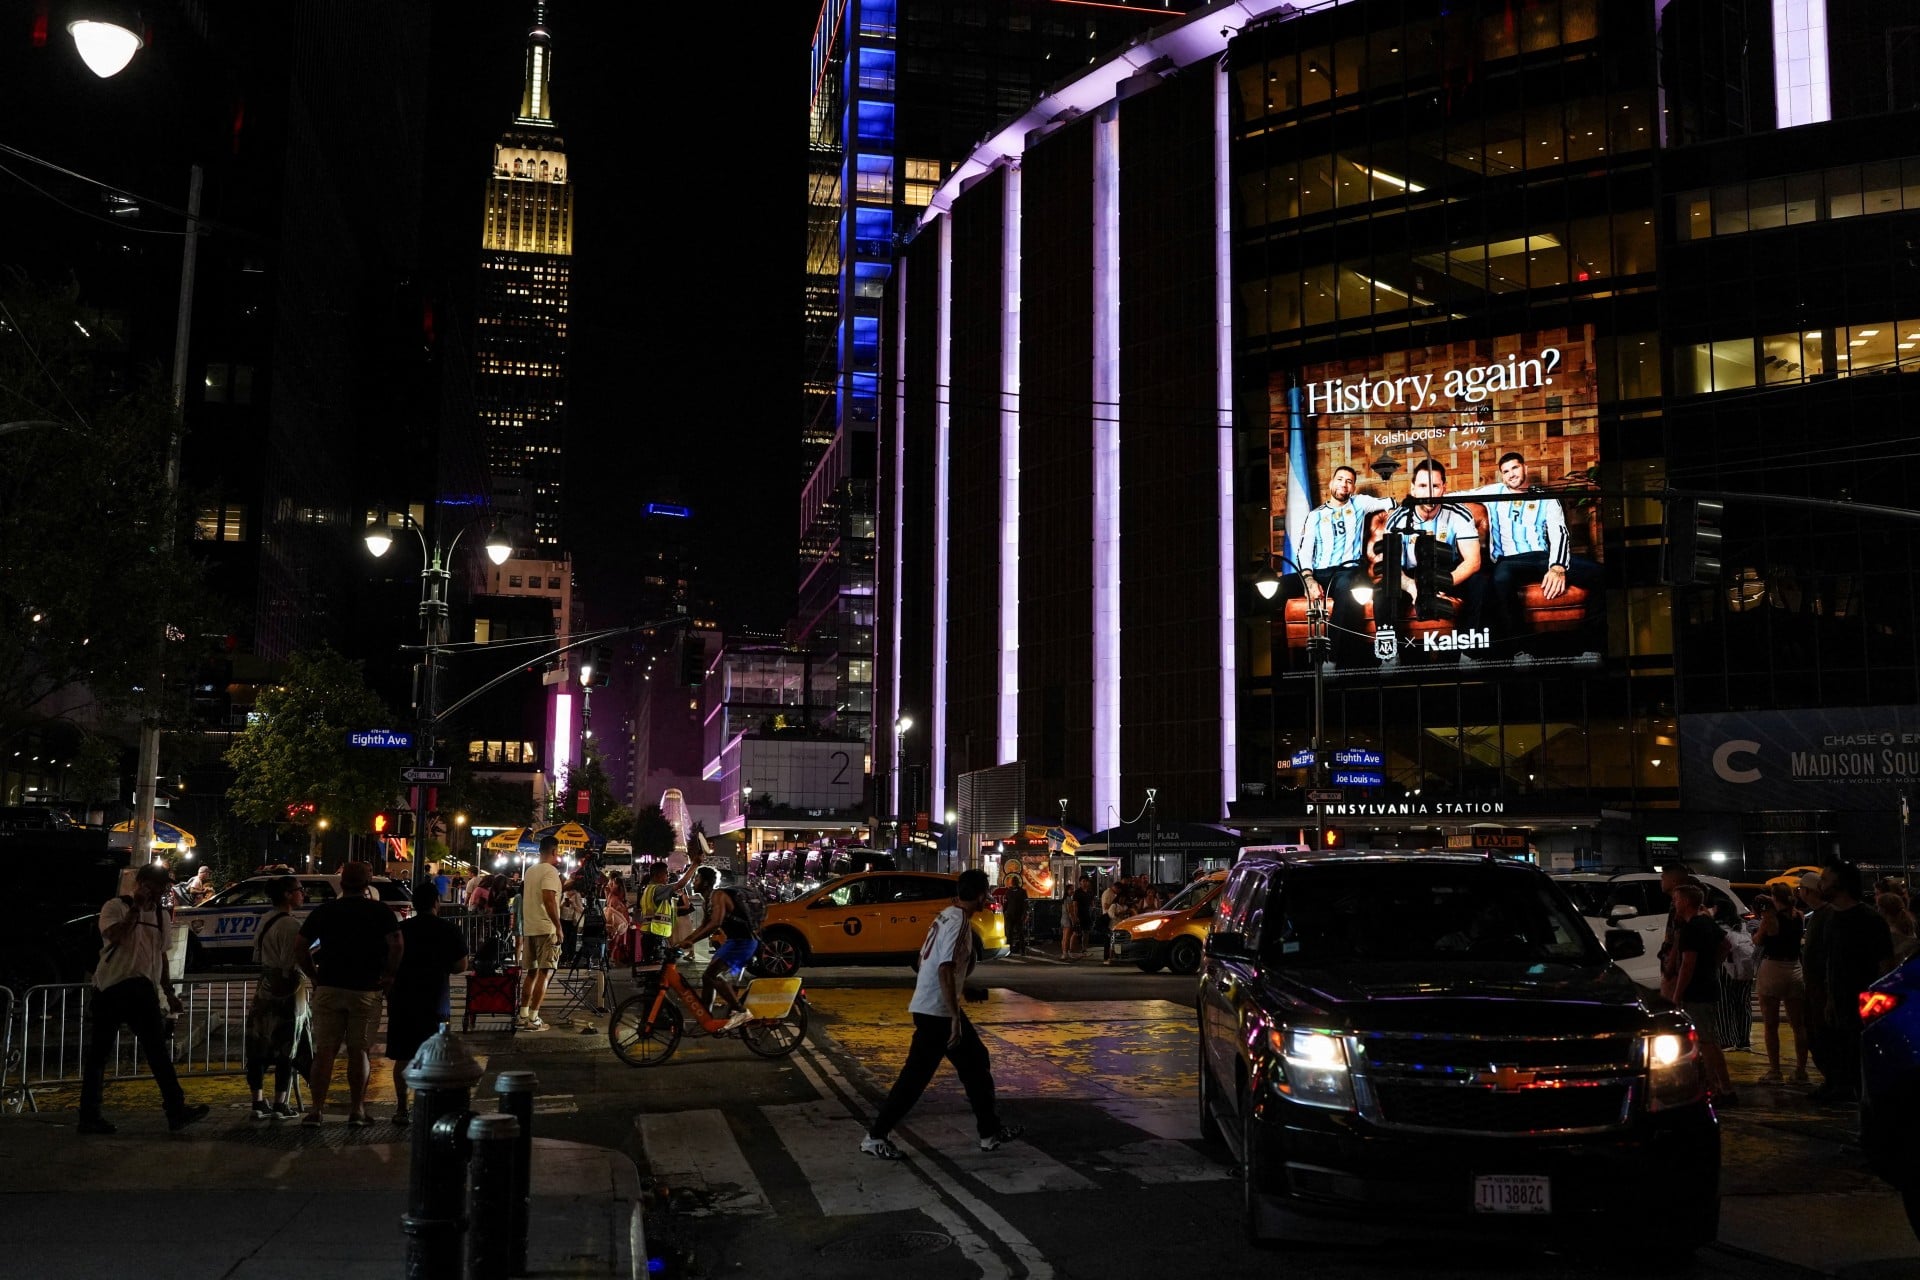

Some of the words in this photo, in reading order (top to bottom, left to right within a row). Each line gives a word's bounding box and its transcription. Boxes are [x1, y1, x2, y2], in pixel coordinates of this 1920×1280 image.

[1307, 373, 1436, 417] History,
[1444, 348, 1560, 402] again?
[1374, 430, 1409, 445] Kalshi
[1411, 428, 1445, 441] odds:
[1461, 421, 1486, 435] 21%
[1423, 627, 1489, 652] Kalshi
[352, 734, 385, 747] Eighth
[387, 735, 407, 745] Ave
[1823, 734, 1878, 746] CHASE
[1335, 752, 1362, 764] Eighth
[1363, 754, 1380, 763] Ave
[1791, 751, 1876, 777] MADISON
[830, 751, 850, 785] 2
[1336, 774, 1348, 783] Joe
[1350, 774, 1368, 783] Louis
[1436, 802, 1504, 813] STATION
[1157, 832, 1180, 840] PLAZA
[1480, 836, 1508, 846] TAXI
